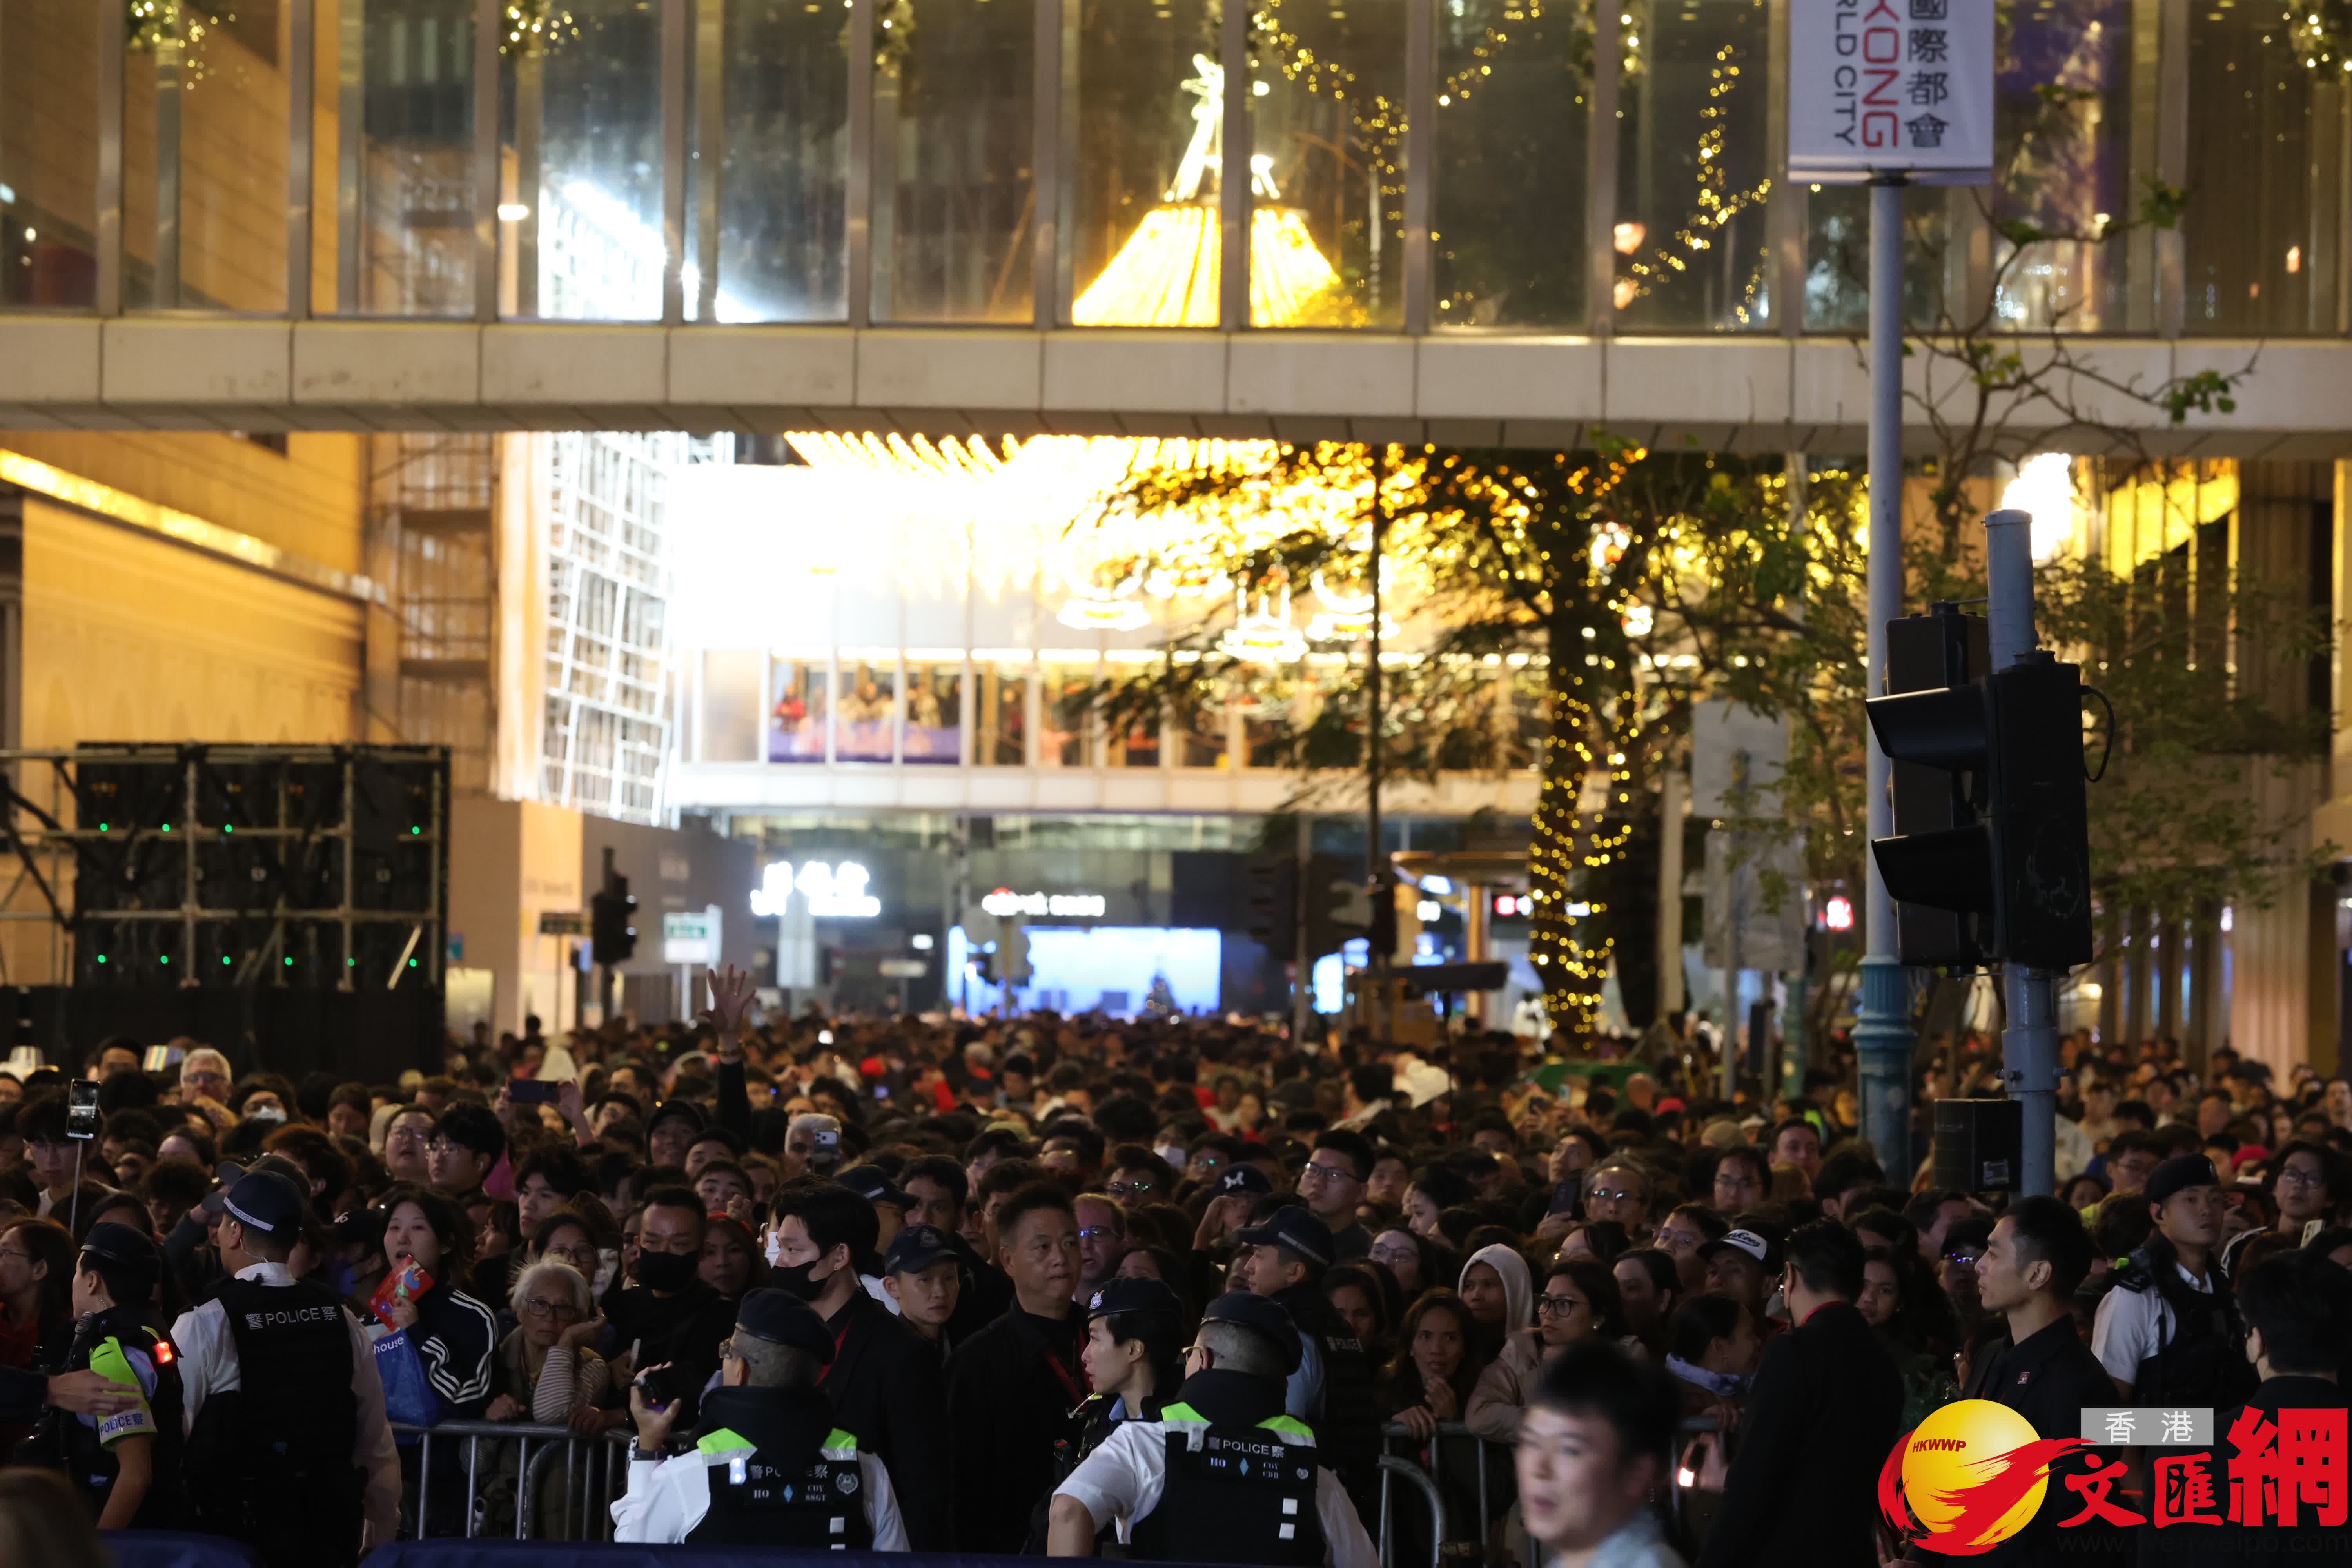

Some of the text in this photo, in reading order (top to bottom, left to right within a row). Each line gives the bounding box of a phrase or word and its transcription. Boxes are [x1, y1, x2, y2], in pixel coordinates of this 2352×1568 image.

[1862, 0, 1900, 147] KONG
[1834, 65, 1857, 147] CITY
[245, 1306, 338, 1330] 警 POLICE 察
[373, 1336, 404, 1354] house
[100, 1416, 132, 1436] POLICE
[1223, 1439, 1269, 1455] POLICE
